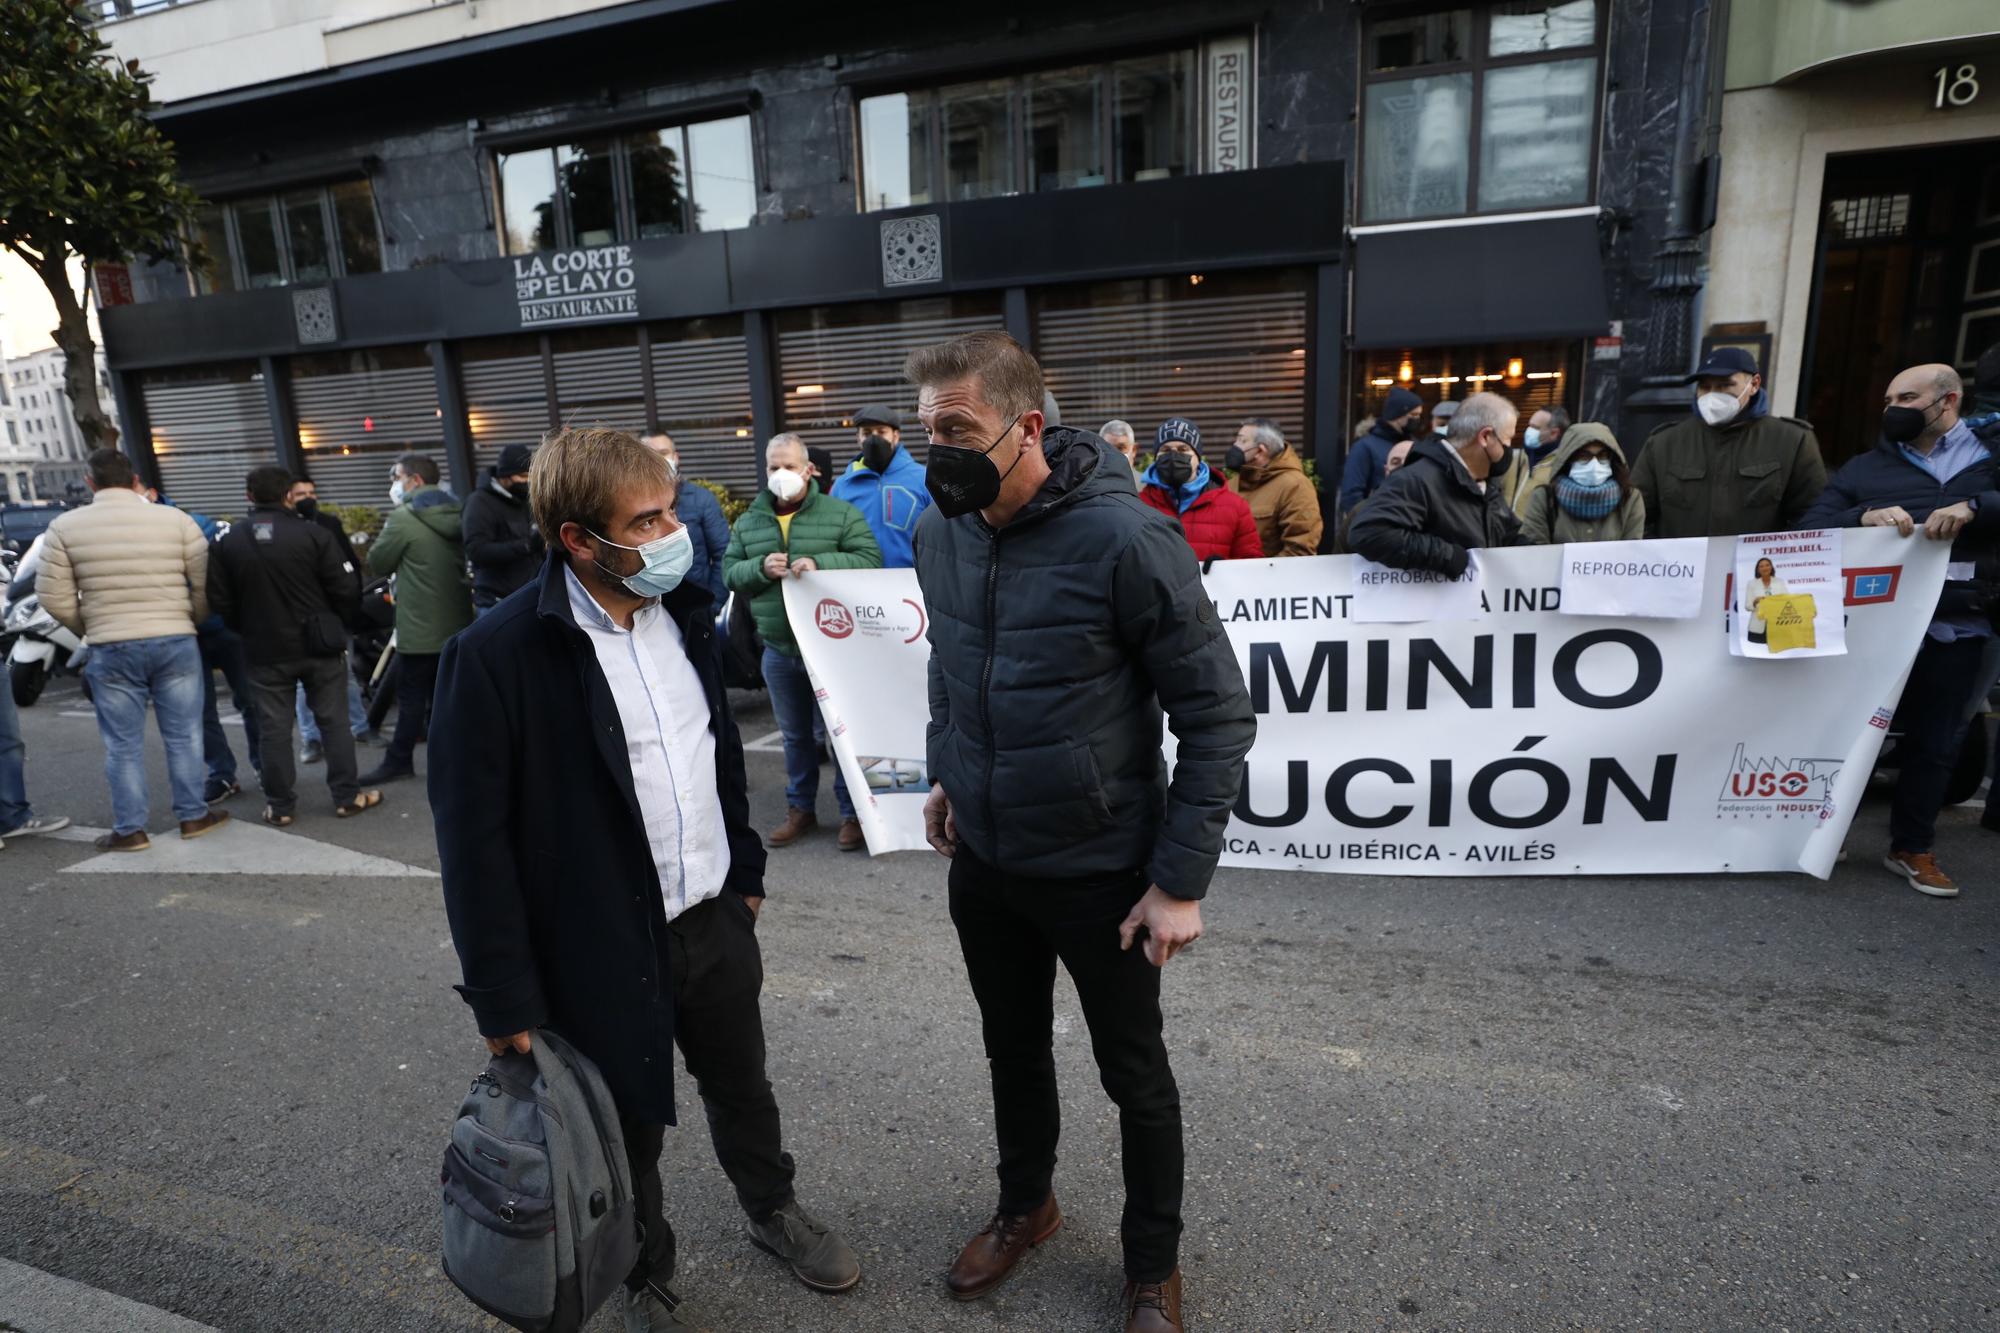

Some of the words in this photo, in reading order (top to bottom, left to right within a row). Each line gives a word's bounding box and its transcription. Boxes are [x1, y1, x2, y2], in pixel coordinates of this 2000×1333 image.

[1934, 64, 1979, 108] 18
[514, 256, 548, 279] LA
[552, 245, 633, 274] CORTE
[516, 280, 529, 299] DE
[528, 268, 635, 298] PELAYO
[520, 295, 638, 321] RESTAURANTE
[1361, 569, 1474, 585] REPROBACIN
[1572, 560, 1695, 578] REPROBACIÓN
[855, 605, 886, 618] FICA
[1249, 628, 1663, 714] MINIO
[1231, 735, 1678, 829] UCIÓN
[1732, 771, 1809, 797] USO
[1717, 803, 1772, 812] Federación
[1284, 843, 1331, 859] ALU
[1340, 839, 1440, 860] IBÉRICA
[1465, 840, 1556, 862] AVILÉS
